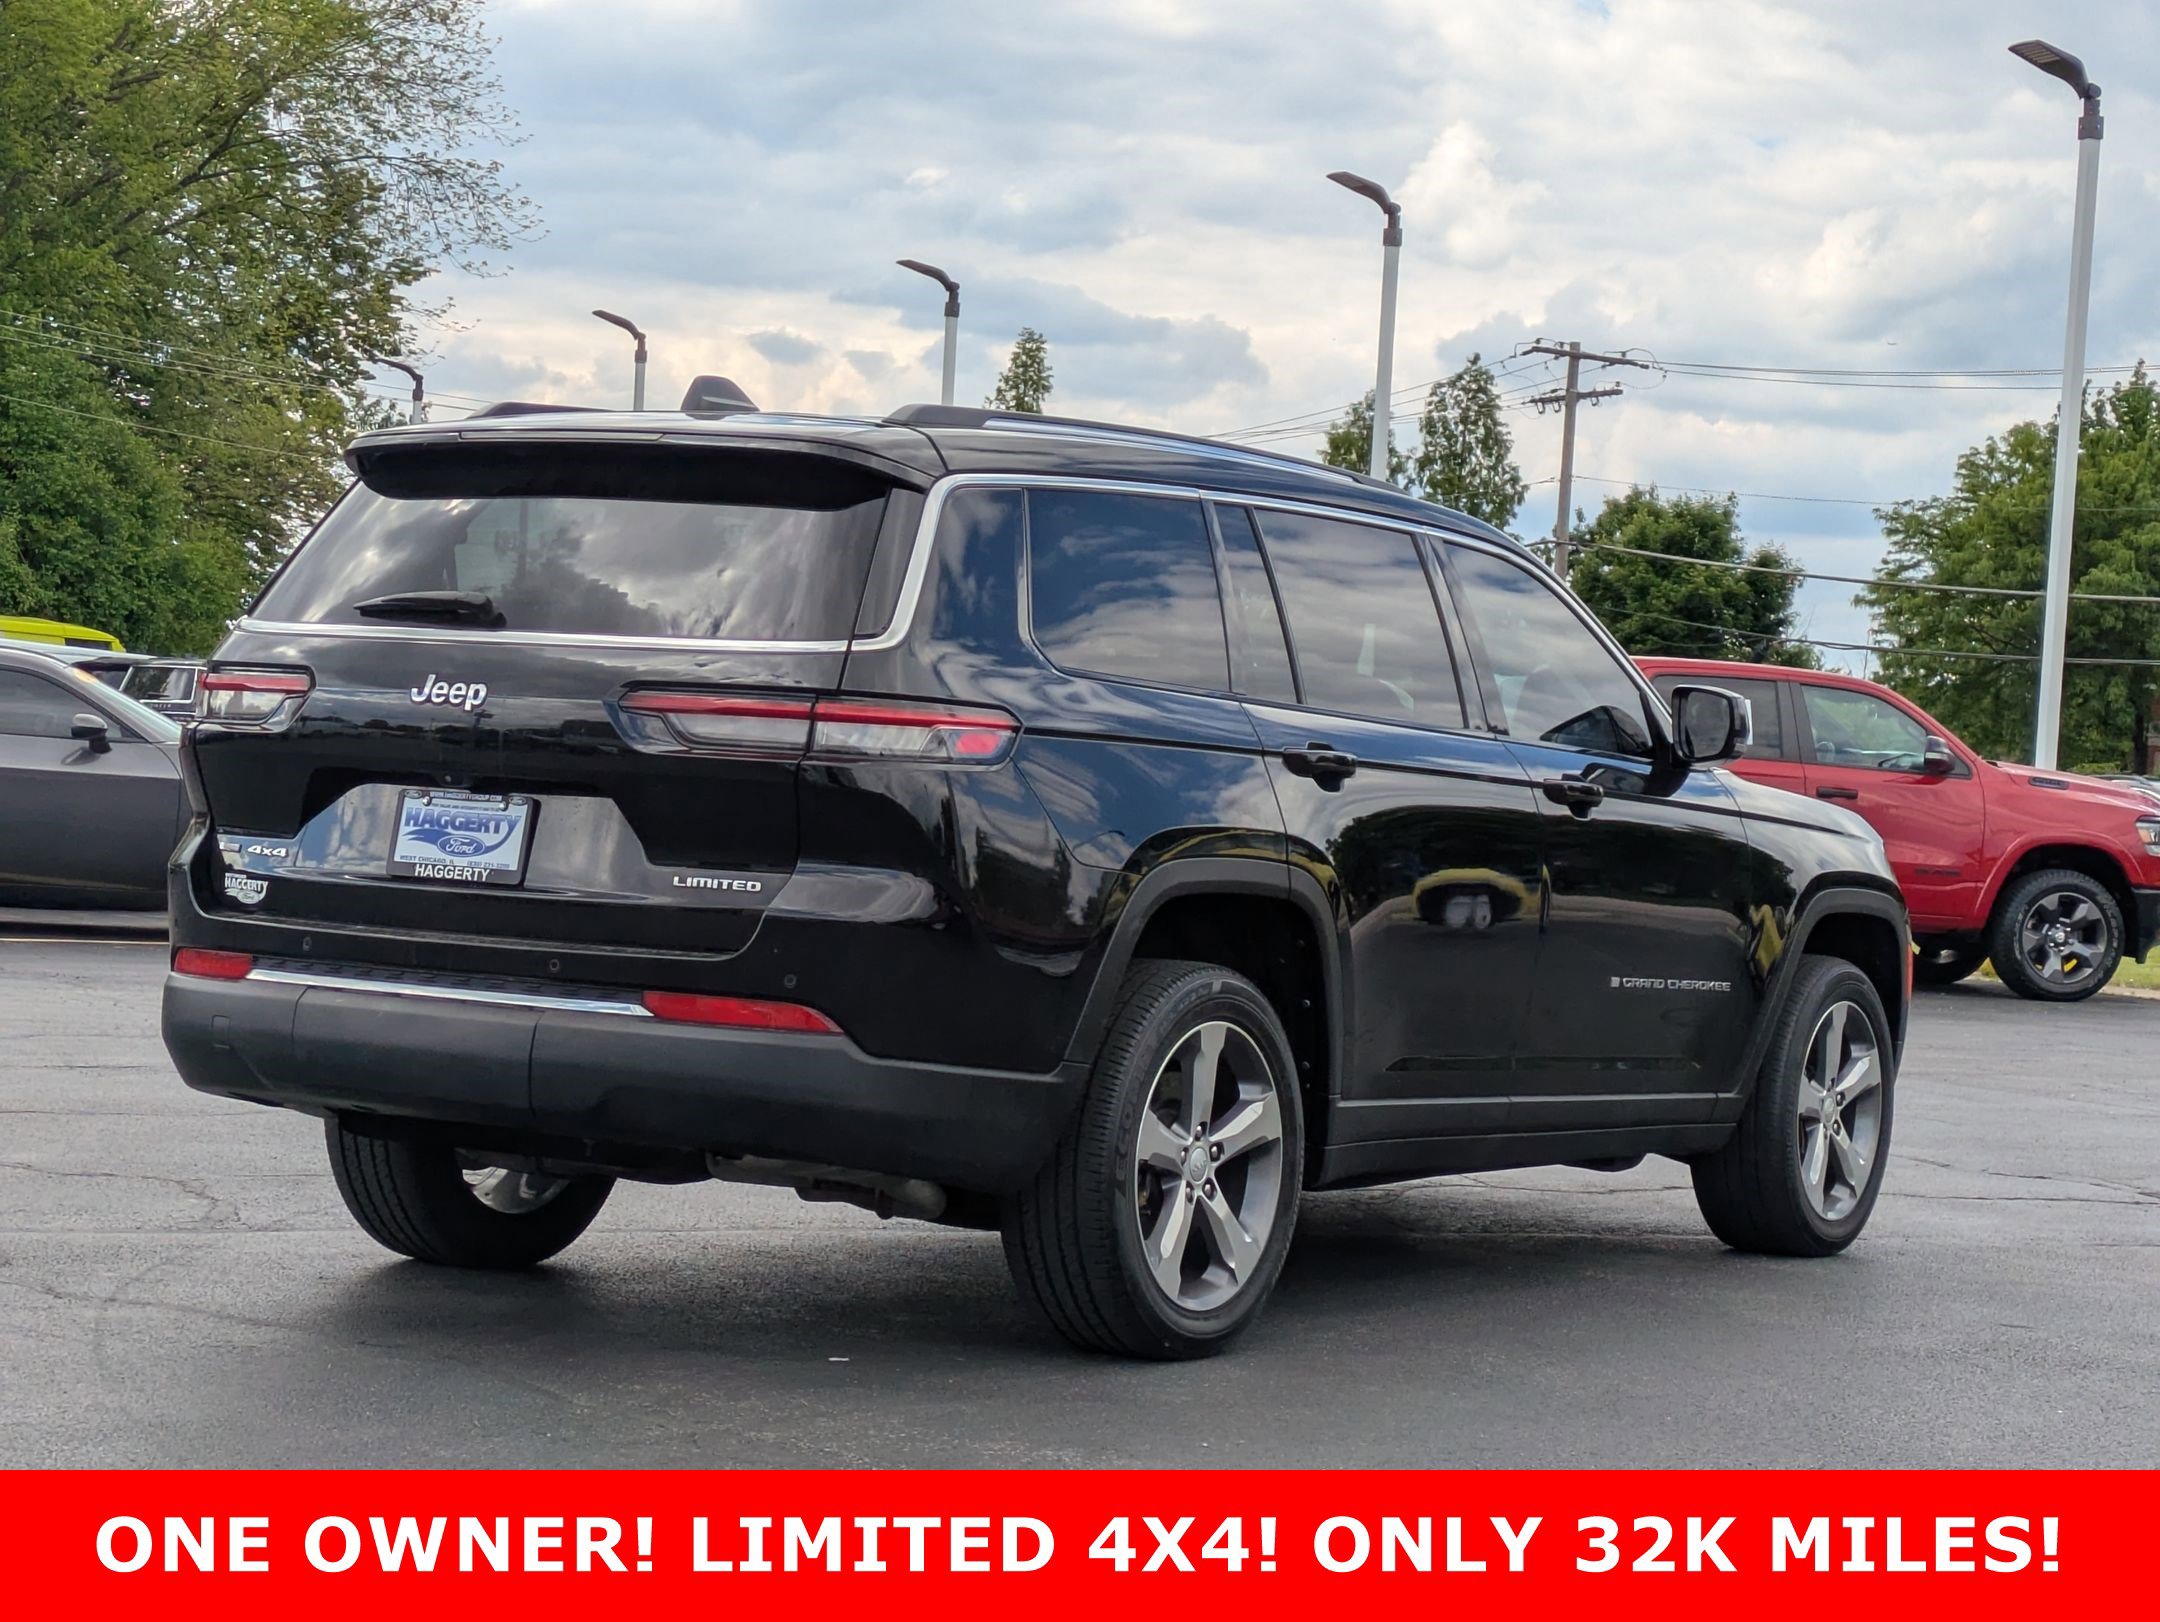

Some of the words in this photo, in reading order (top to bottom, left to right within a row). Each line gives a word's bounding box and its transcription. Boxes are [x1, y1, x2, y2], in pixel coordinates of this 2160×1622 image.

[411, 674, 487, 711] Jeep
[404, 807, 522, 835] HAGGERTY
[446, 838, 477, 854] Ford
[415, 863, 490, 882] HAGGERTY
[225, 876, 269, 892] HAGGERTY
[673, 876, 762, 892] LIMITED
[1622, 977, 1665, 989] GRAND
[1667, 979, 1732, 992] CHEROKEE
